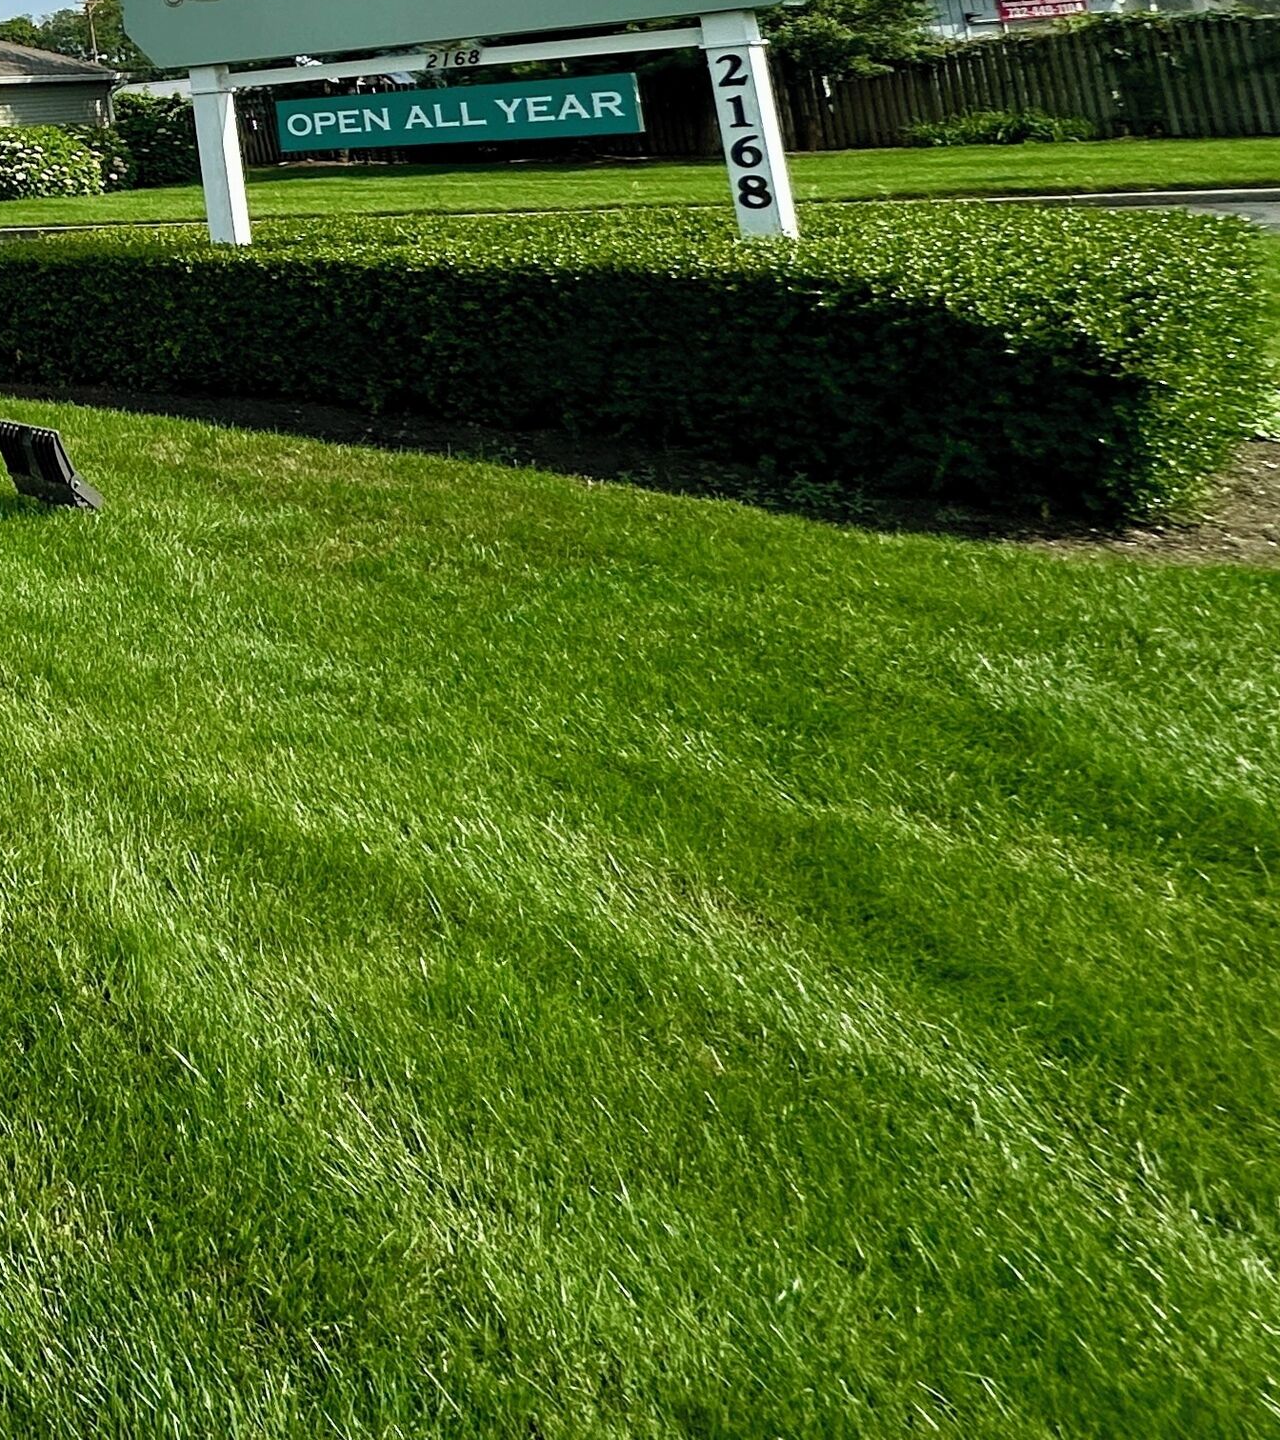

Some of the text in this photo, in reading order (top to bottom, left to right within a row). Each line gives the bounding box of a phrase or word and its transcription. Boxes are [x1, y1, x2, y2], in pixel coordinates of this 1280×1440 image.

[426, 49, 480, 69] 2168
[287, 91, 626, 137] OPEN ALL YEAR
[715, 54, 772, 209] 2168
